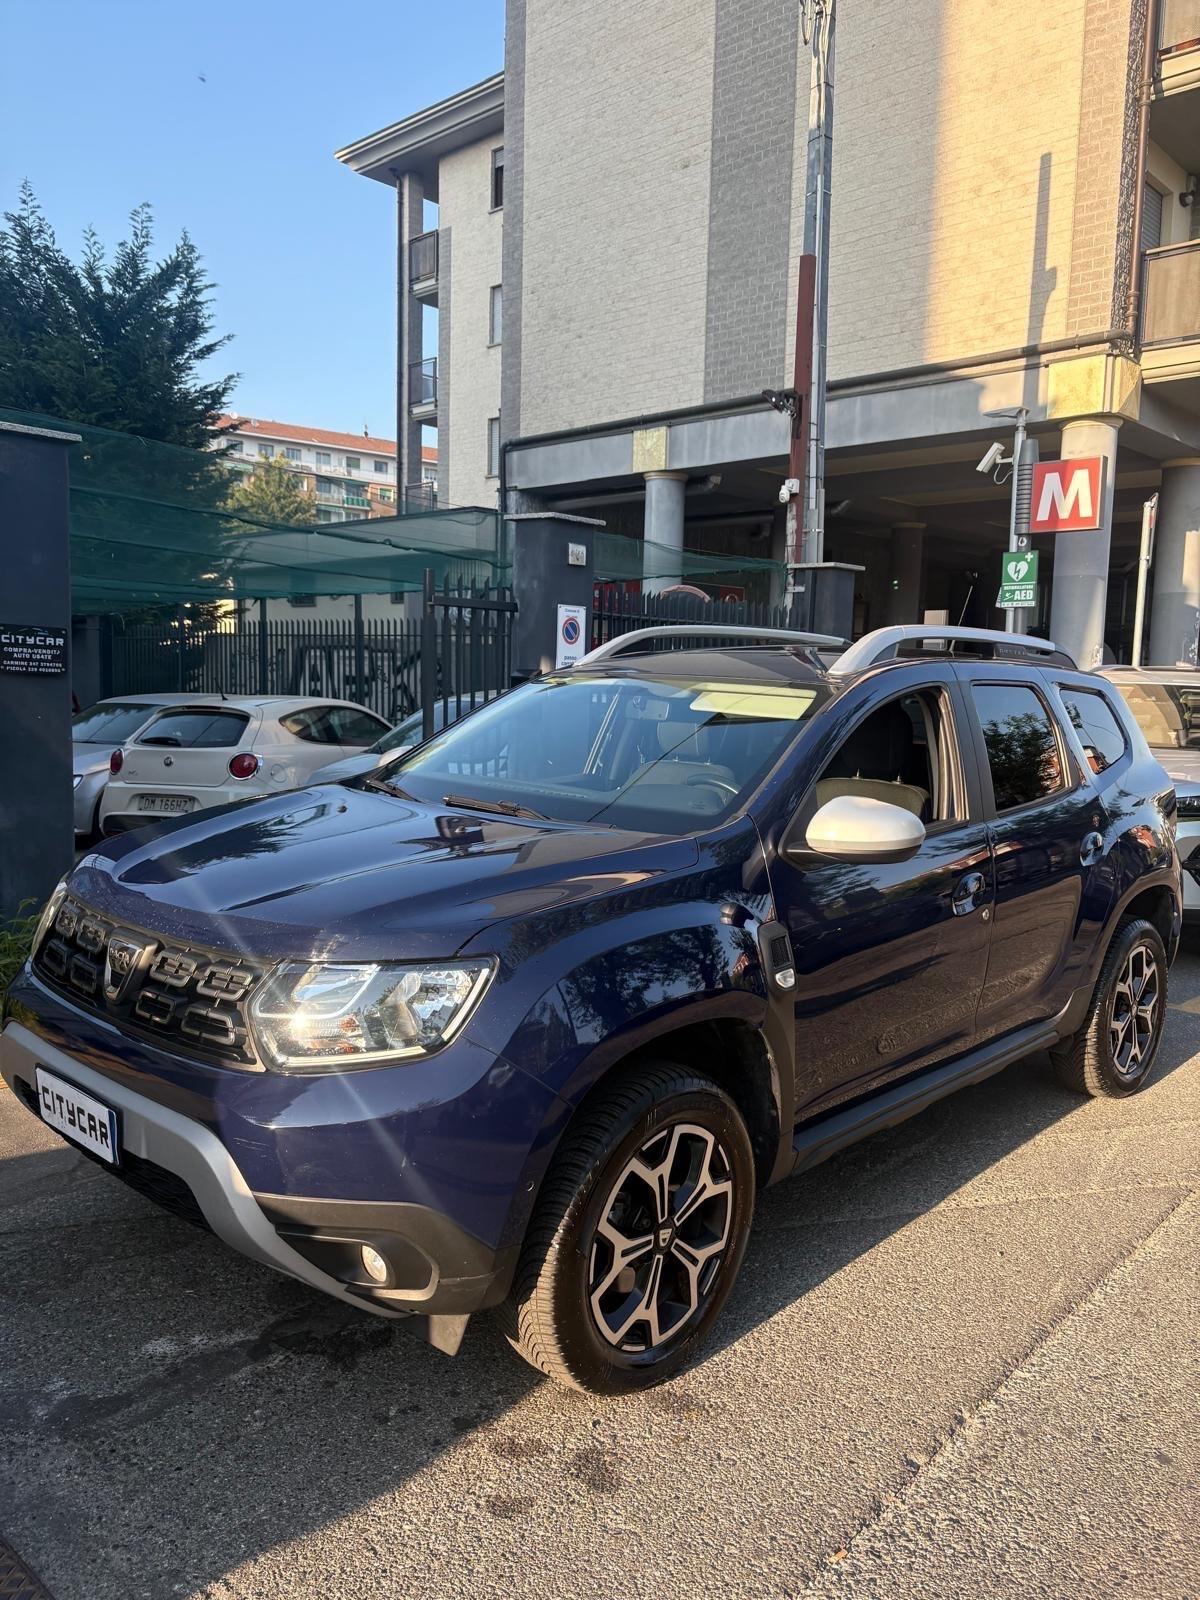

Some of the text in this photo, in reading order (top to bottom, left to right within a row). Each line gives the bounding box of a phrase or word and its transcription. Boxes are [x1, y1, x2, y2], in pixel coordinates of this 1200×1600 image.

[1036, 469, 1093, 521] M
[1013, 590, 1034, 601] AED
[1, 634, 65, 647] CITYCAR
[41, 1085, 109, 1149] CITYCAR
